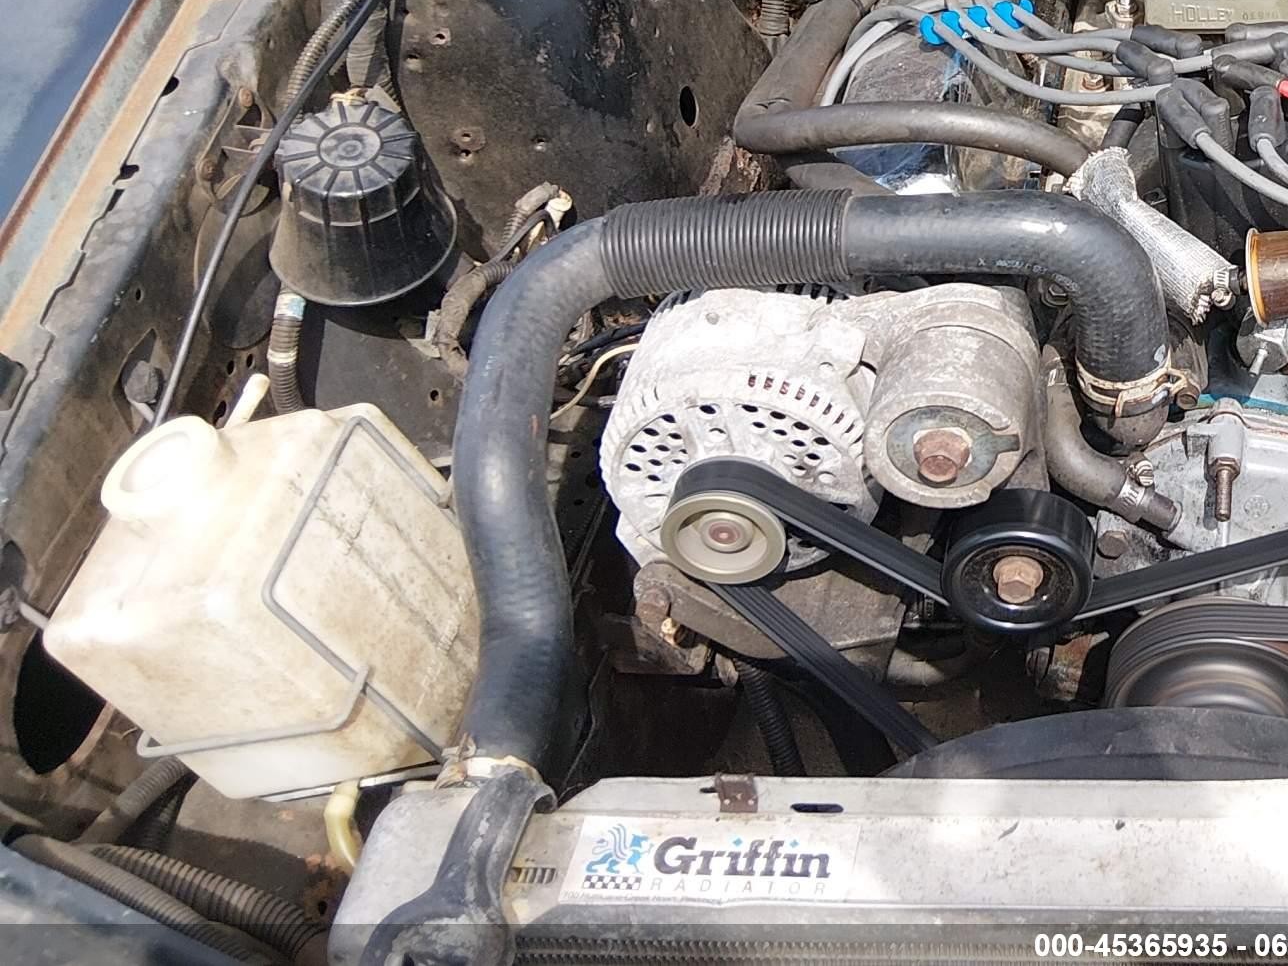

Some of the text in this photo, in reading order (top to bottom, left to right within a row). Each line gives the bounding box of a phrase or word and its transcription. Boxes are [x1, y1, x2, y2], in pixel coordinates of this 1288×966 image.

[1171, 3, 1234, 23] HOLLEY
[653, 835, 831, 878] Griffin
[650, 878, 827, 895] RADIATOR
